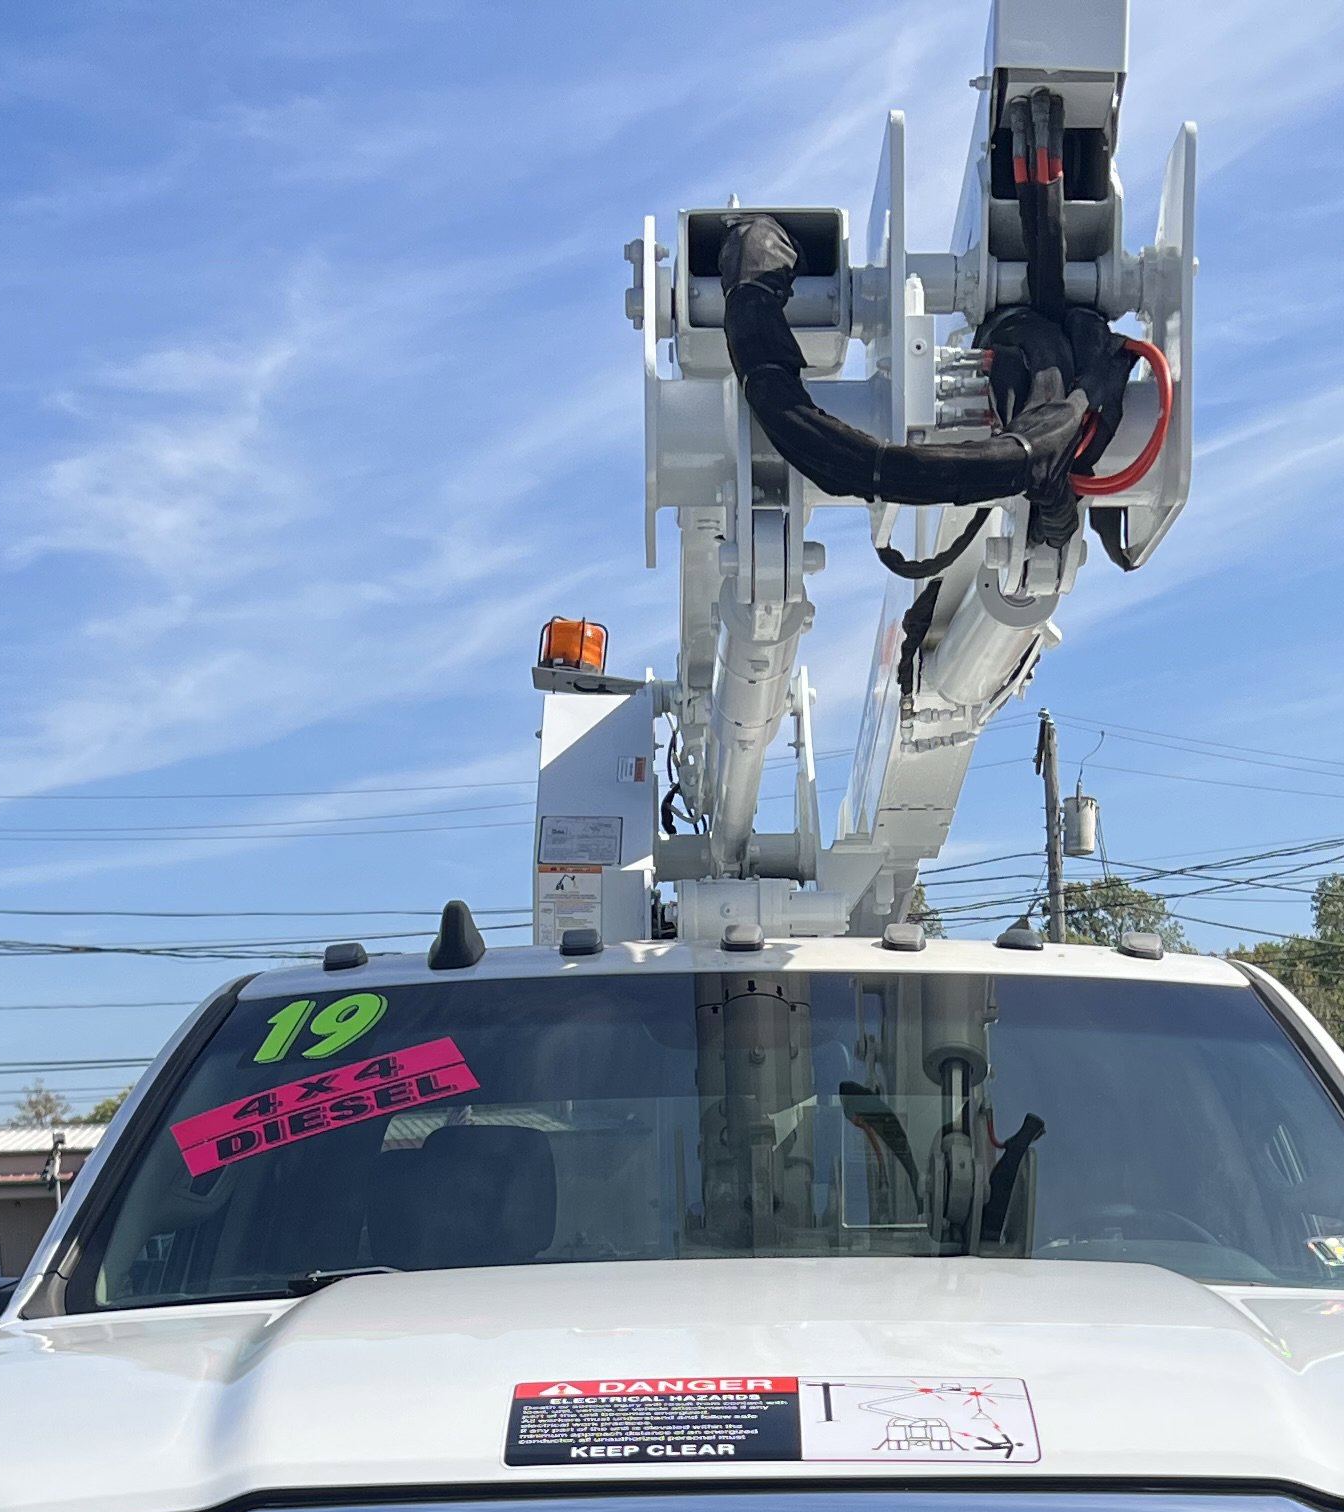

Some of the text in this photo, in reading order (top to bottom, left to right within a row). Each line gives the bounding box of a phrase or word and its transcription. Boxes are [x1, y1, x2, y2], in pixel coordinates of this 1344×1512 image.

[253, 992, 389, 1064] 19
[215, 1074, 458, 1162] DIESEL
[599, 1379, 773, 1393] DANGER
[550, 1396, 665, 1404] ELECTRICAL
[570, 1443, 736, 1458] KEEP CLEAR
